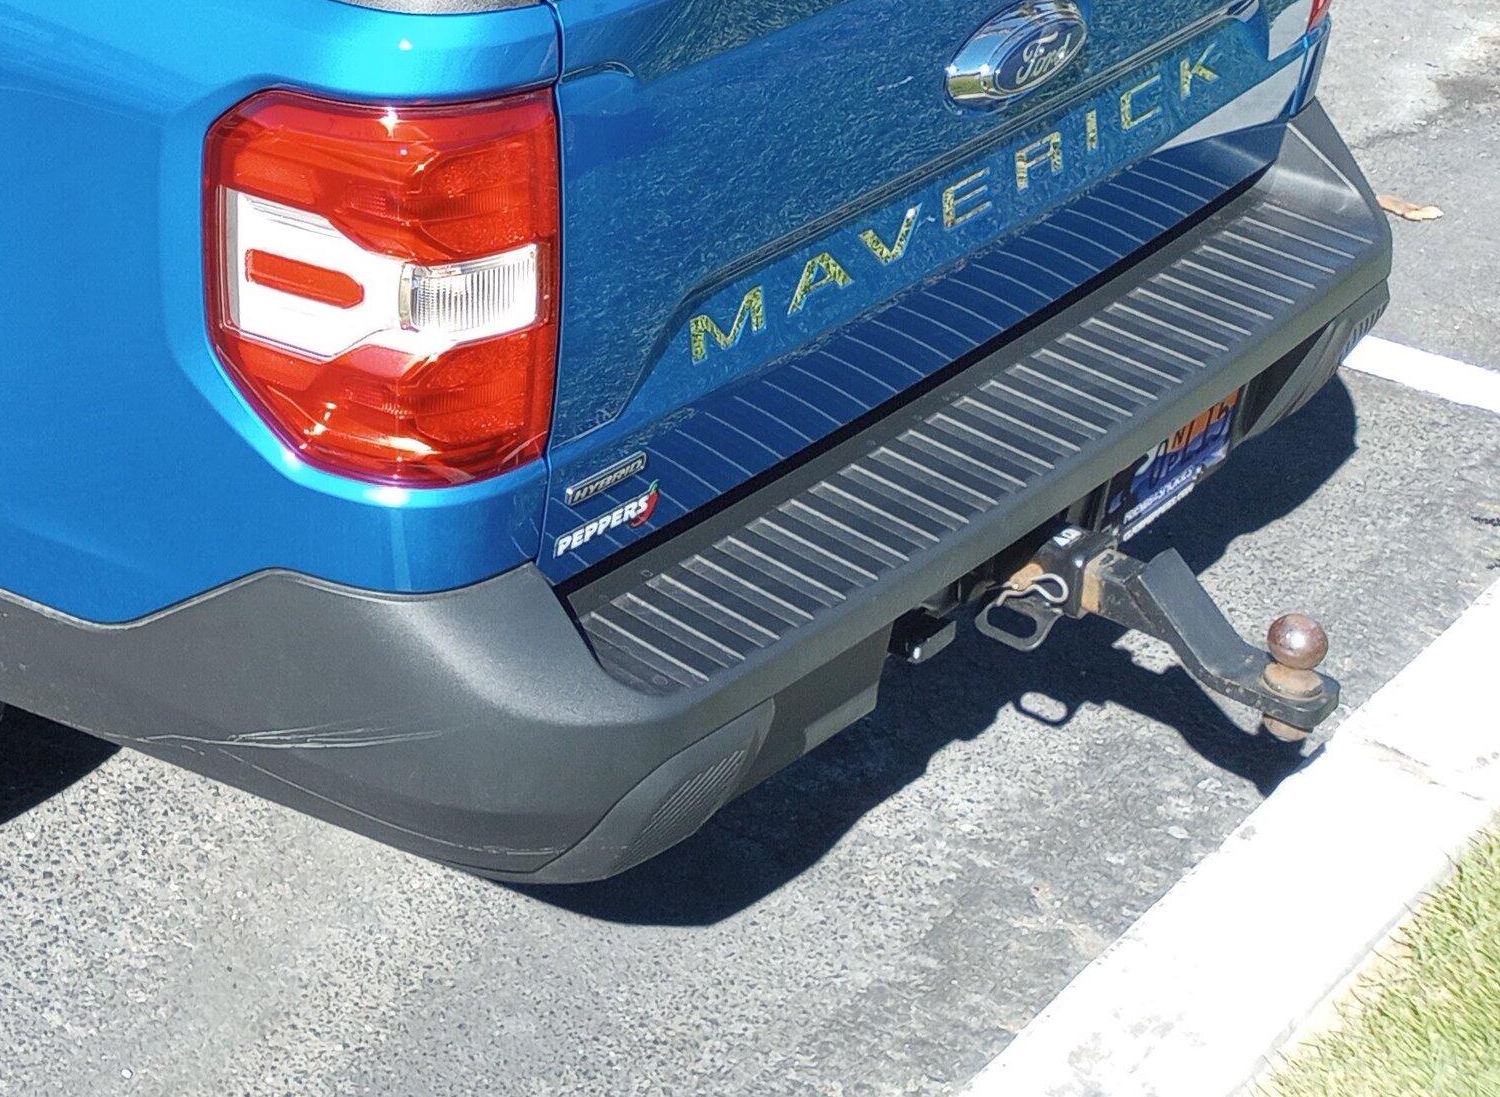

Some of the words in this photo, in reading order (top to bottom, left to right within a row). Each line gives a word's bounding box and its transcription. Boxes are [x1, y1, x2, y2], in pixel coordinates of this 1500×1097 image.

[1015, 30, 1072, 85] Ford
[689, 43, 1220, 365] MAVERICK
[572, 458, 644, 502] HYBRID
[556, 494, 650, 557] PEPPERS
